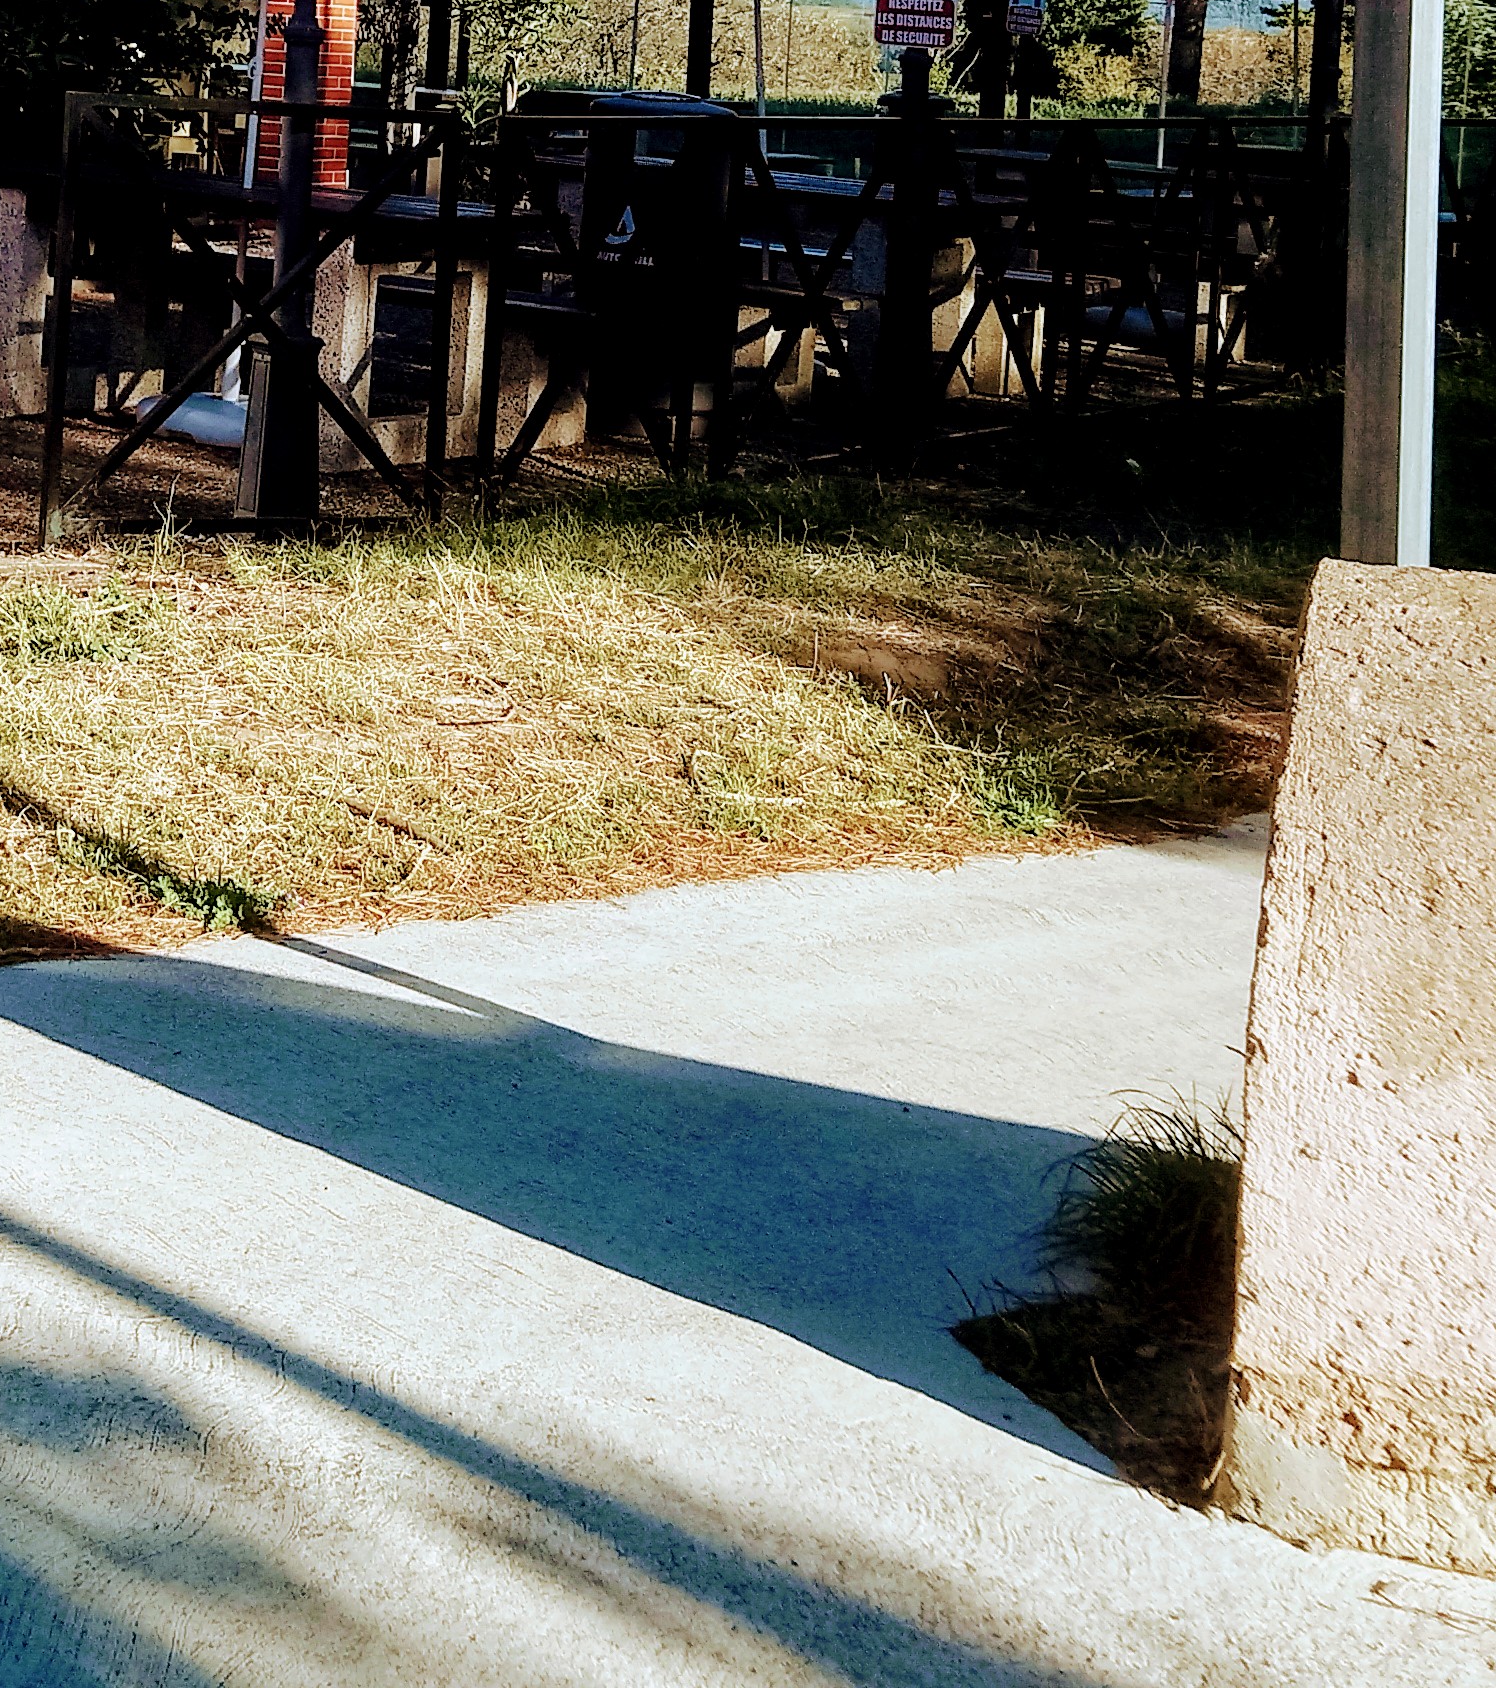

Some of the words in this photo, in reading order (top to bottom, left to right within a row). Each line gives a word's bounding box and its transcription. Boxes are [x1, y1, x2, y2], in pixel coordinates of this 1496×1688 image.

[877, 12, 895, 26] LES
[896, 14, 953, 30] DISTANCES
[881, 29, 895, 42] DE
[895, 30, 946, 46] SECURITE
